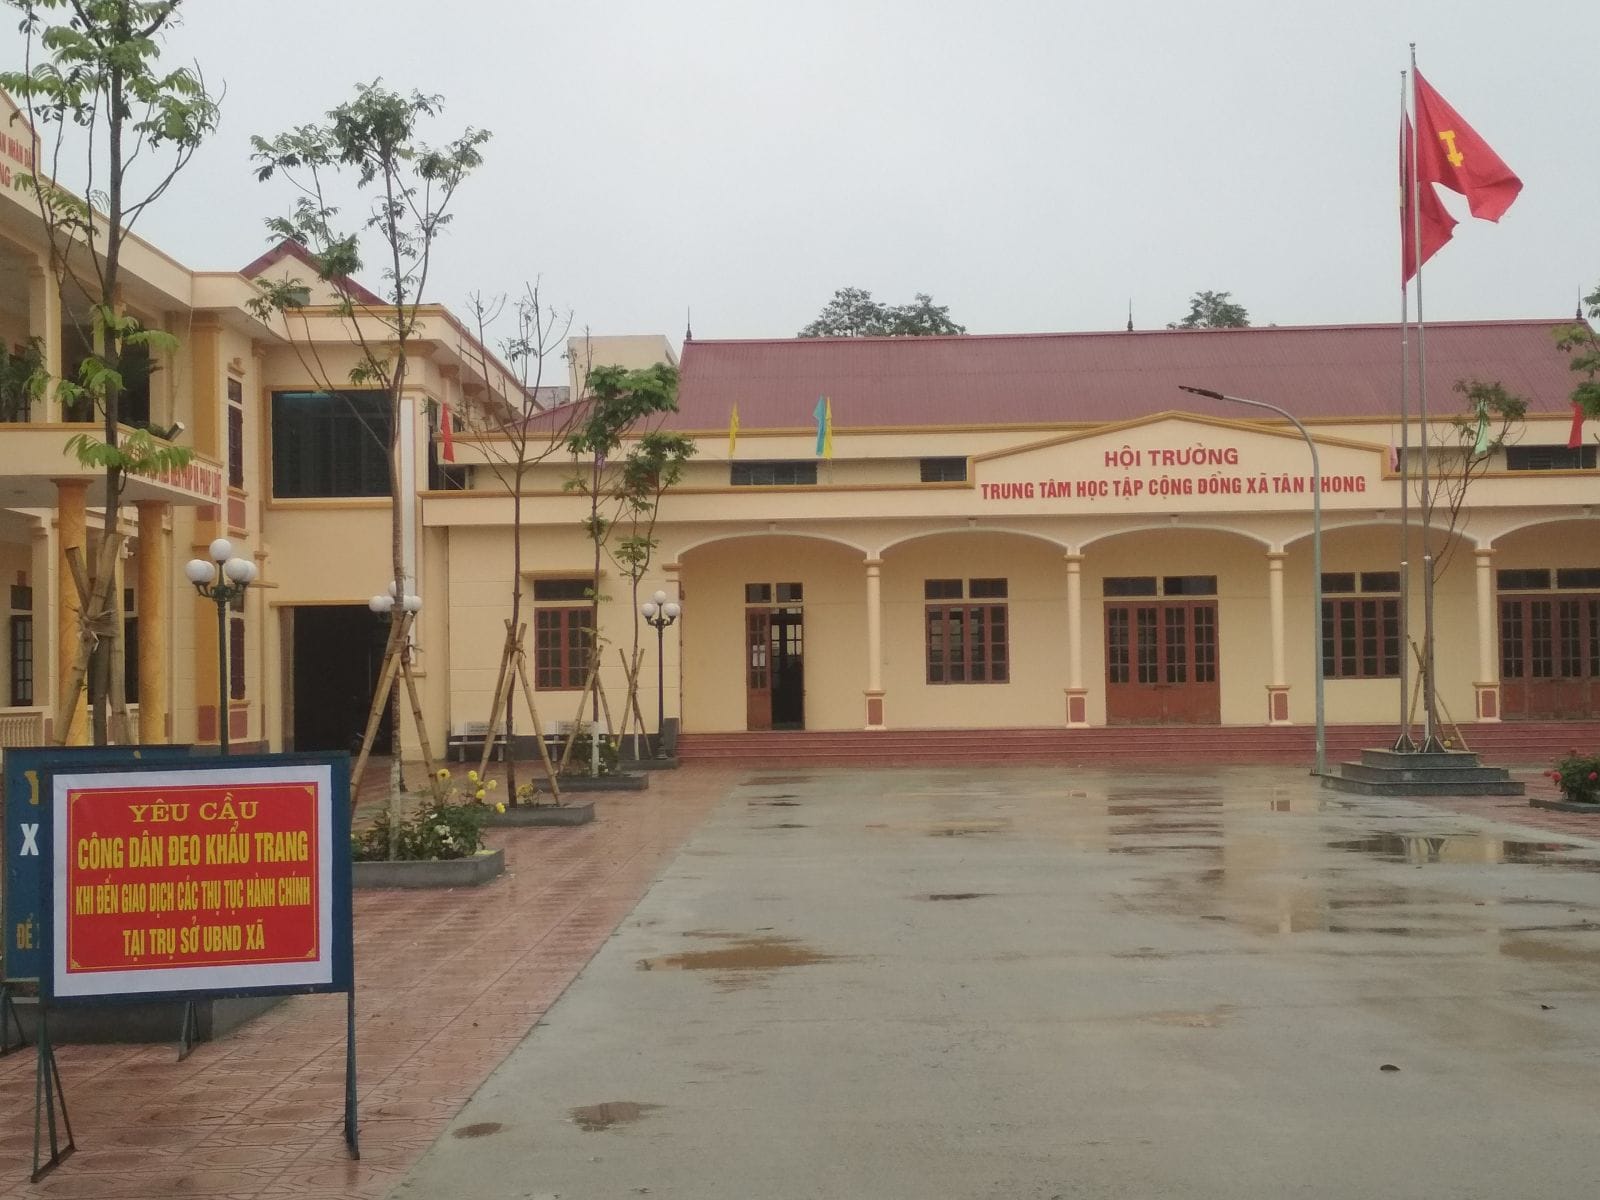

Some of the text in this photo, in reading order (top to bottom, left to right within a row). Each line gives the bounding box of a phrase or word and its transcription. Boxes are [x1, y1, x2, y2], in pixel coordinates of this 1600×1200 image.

[1105, 442, 1239, 470] HỘI TRƯỜNG
[980, 483, 1034, 500] TRUNG
[1040, 479, 1071, 498] TÂM
[1077, 480, 1108, 501] HỌC
[1113, 477, 1143, 500] TẬP
[1149, 475, 1193, 500] CỘNG
[1197, 471, 1242, 495] ĐỒNG
[1247, 472, 1269, 494] XÃ
[1273, 473, 1305, 494] TÂN
[128, 792, 259, 823] YÊU CẦU
[78, 820, 309, 870] CÔNG DÂN ĐEO KHẨU TRANG
[76, 885, 94, 915] KHI
[96, 873, 119, 915] ĐẾN
[121, 882, 147, 913] GIAO
[149, 881, 175, 919] DỊCH
[177, 874, 199, 911] CÁC
[223, 879, 244, 916] TỤC
[246, 872, 276, 908] HÀNH
[278, 870, 311, 907] CHÍNH
[122, 915, 265, 962] TẠI TRỤ SỞ UBND XÃ
